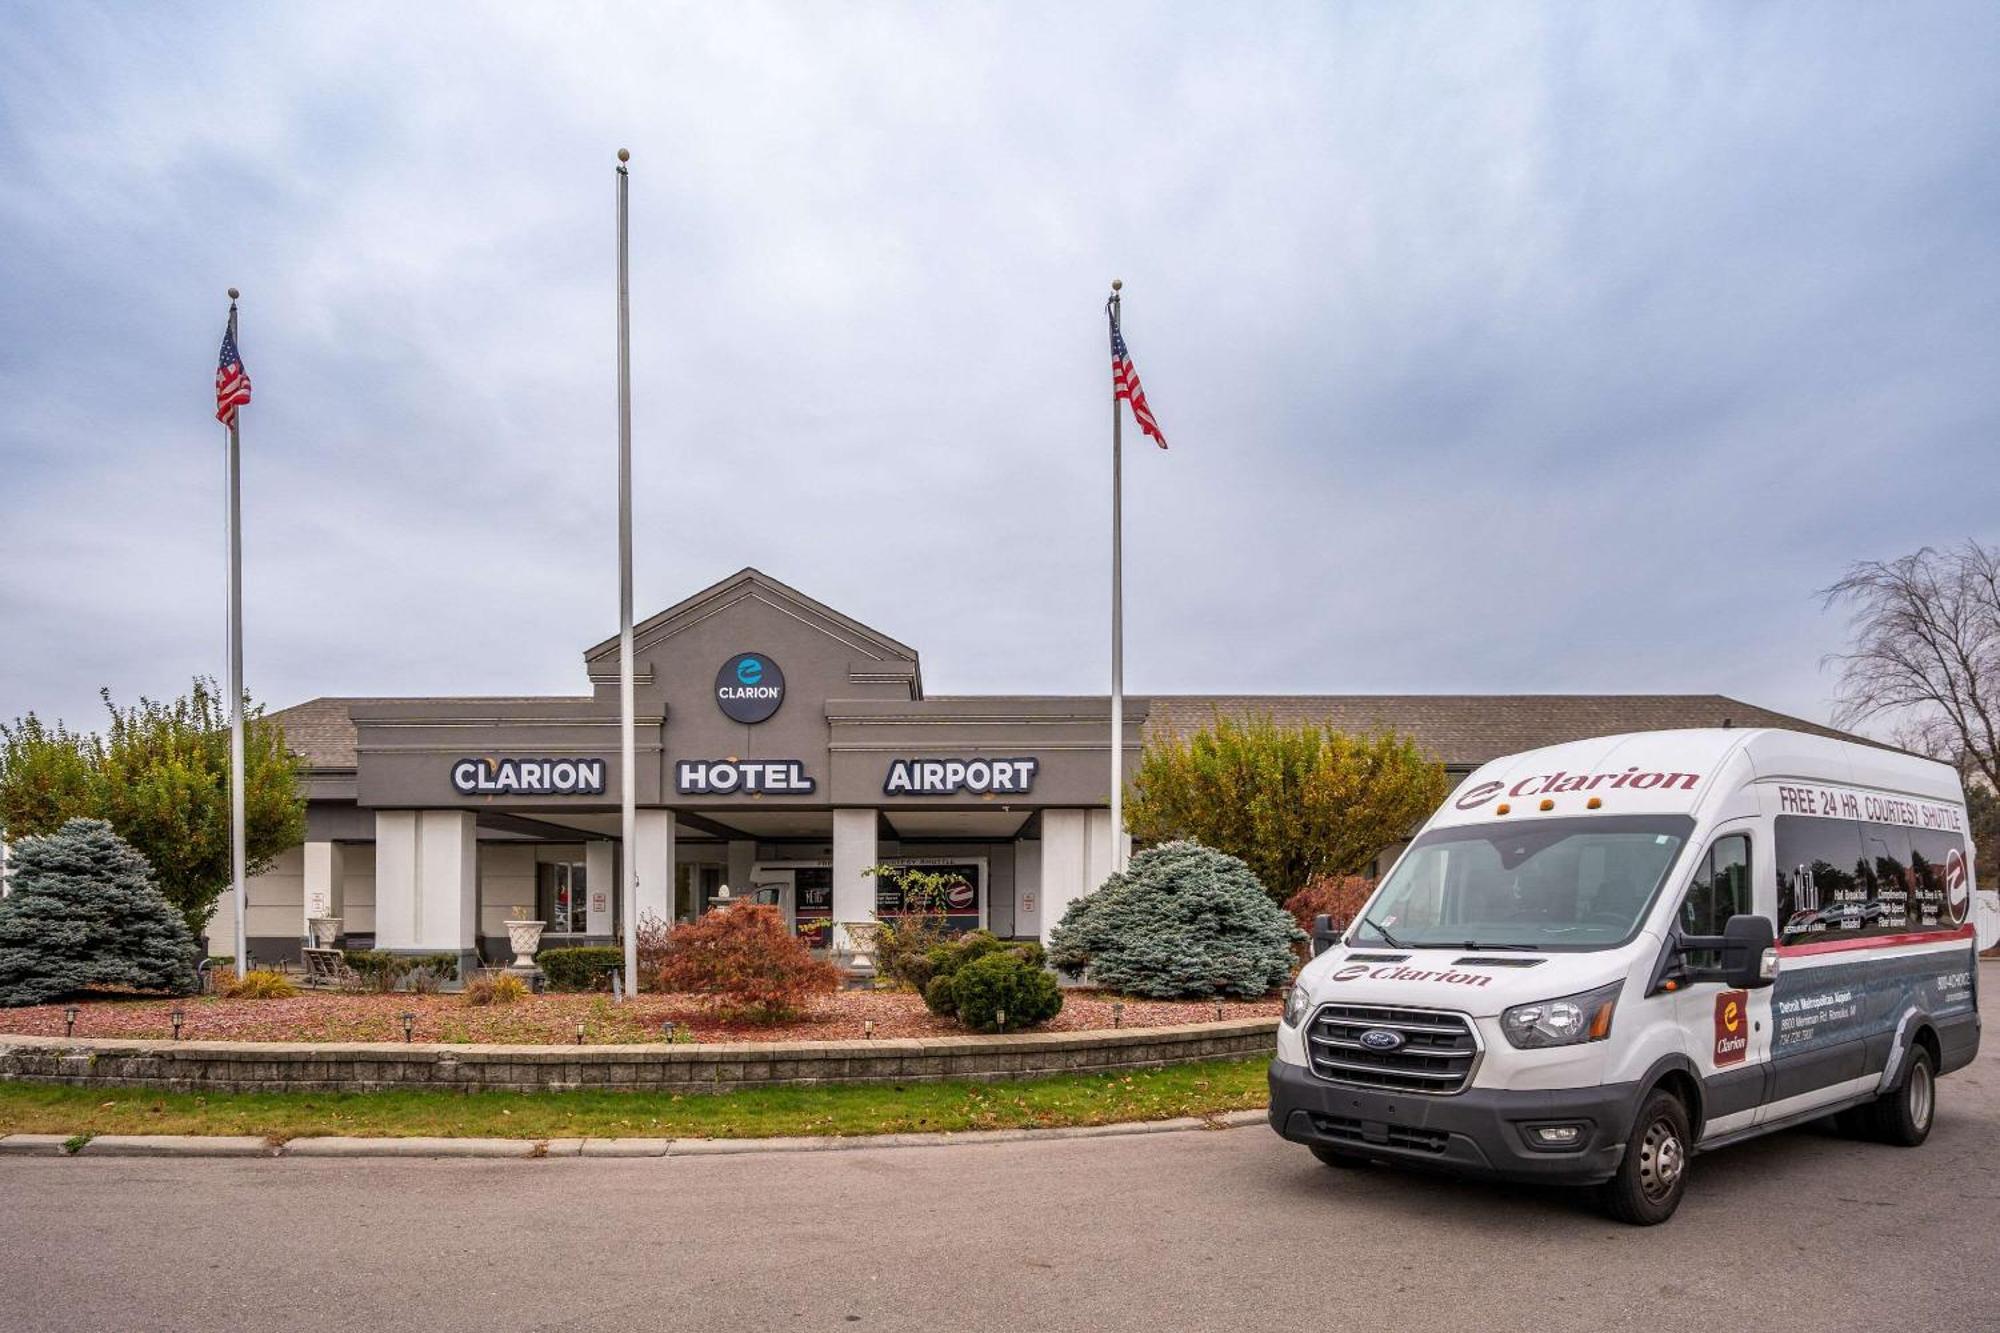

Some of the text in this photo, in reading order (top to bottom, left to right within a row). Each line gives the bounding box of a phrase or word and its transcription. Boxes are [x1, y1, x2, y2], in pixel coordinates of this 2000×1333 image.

[719, 687, 778, 699] CLARION
[455, 762, 1035, 790] CLARION HOTEL AIRPORT
[1508, 766, 1701, 798] Clarion
[1778, 786, 1817, 815] FREE
[1821, 791, 1838, 816] 24
[1865, 796, 1919, 826] COURTESY
[1921, 804, 1961, 831] SHUTTLE
[1369, 965, 1493, 987] Clarion
[1718, 1036, 1746, 1053] Clarion
